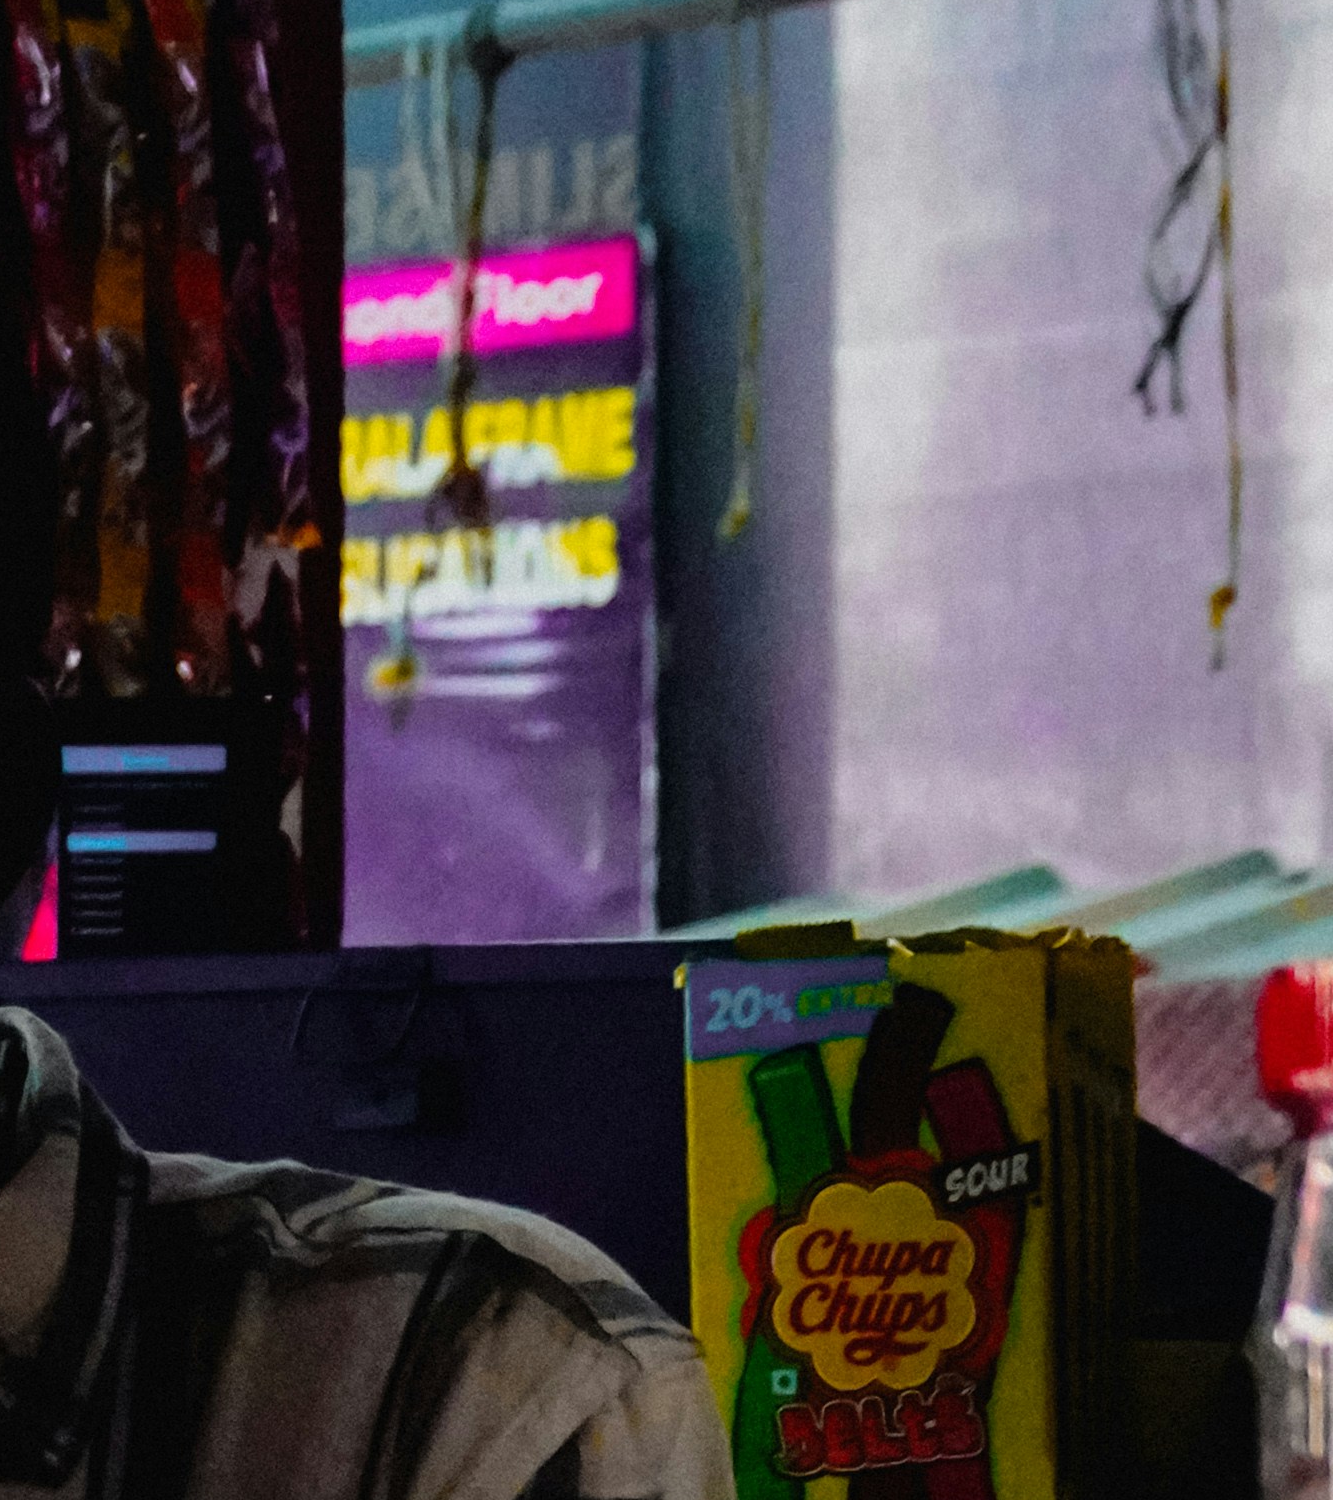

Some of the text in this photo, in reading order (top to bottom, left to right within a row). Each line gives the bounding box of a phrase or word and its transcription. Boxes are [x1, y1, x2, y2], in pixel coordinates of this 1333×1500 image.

[705, 983, 793, 1033] 20%
[945, 1152, 1031, 1205] SOUR
[797, 1228, 957, 1290] Chupa
[790, 1280, 948, 1367] Chups
